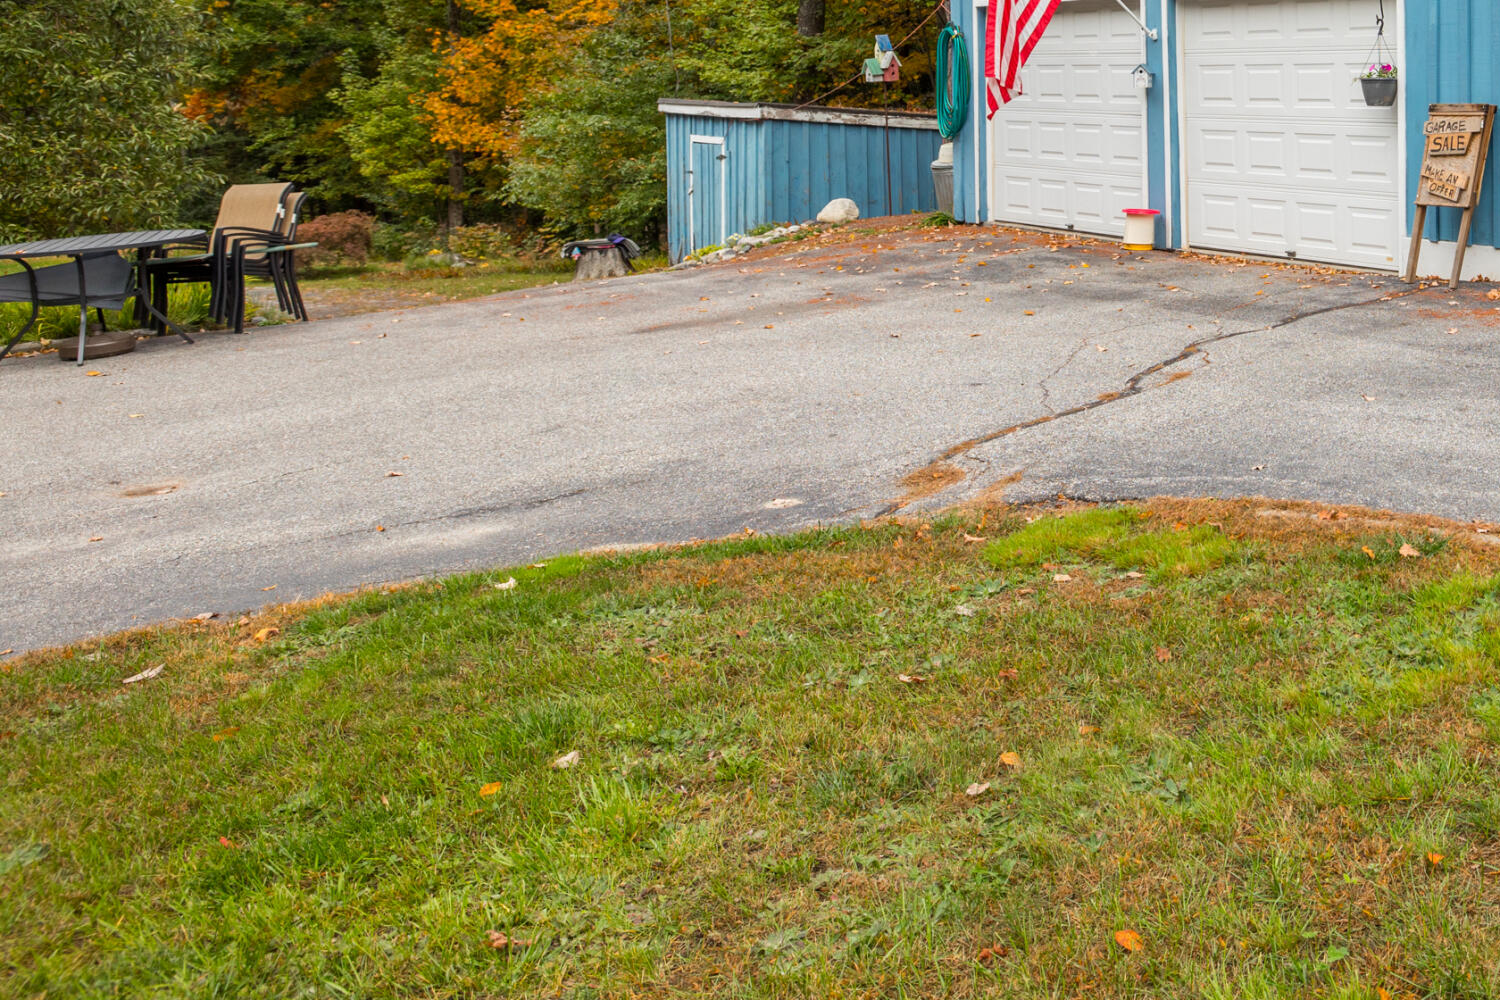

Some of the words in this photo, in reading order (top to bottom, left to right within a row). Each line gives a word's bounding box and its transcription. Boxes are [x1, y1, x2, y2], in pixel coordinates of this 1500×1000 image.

[1425, 120, 1467, 133] GARAGE
[1430, 136, 1465, 152] SALE
[1446, 173, 1459, 184] AN
[1429, 182, 1454, 198] OFFER
